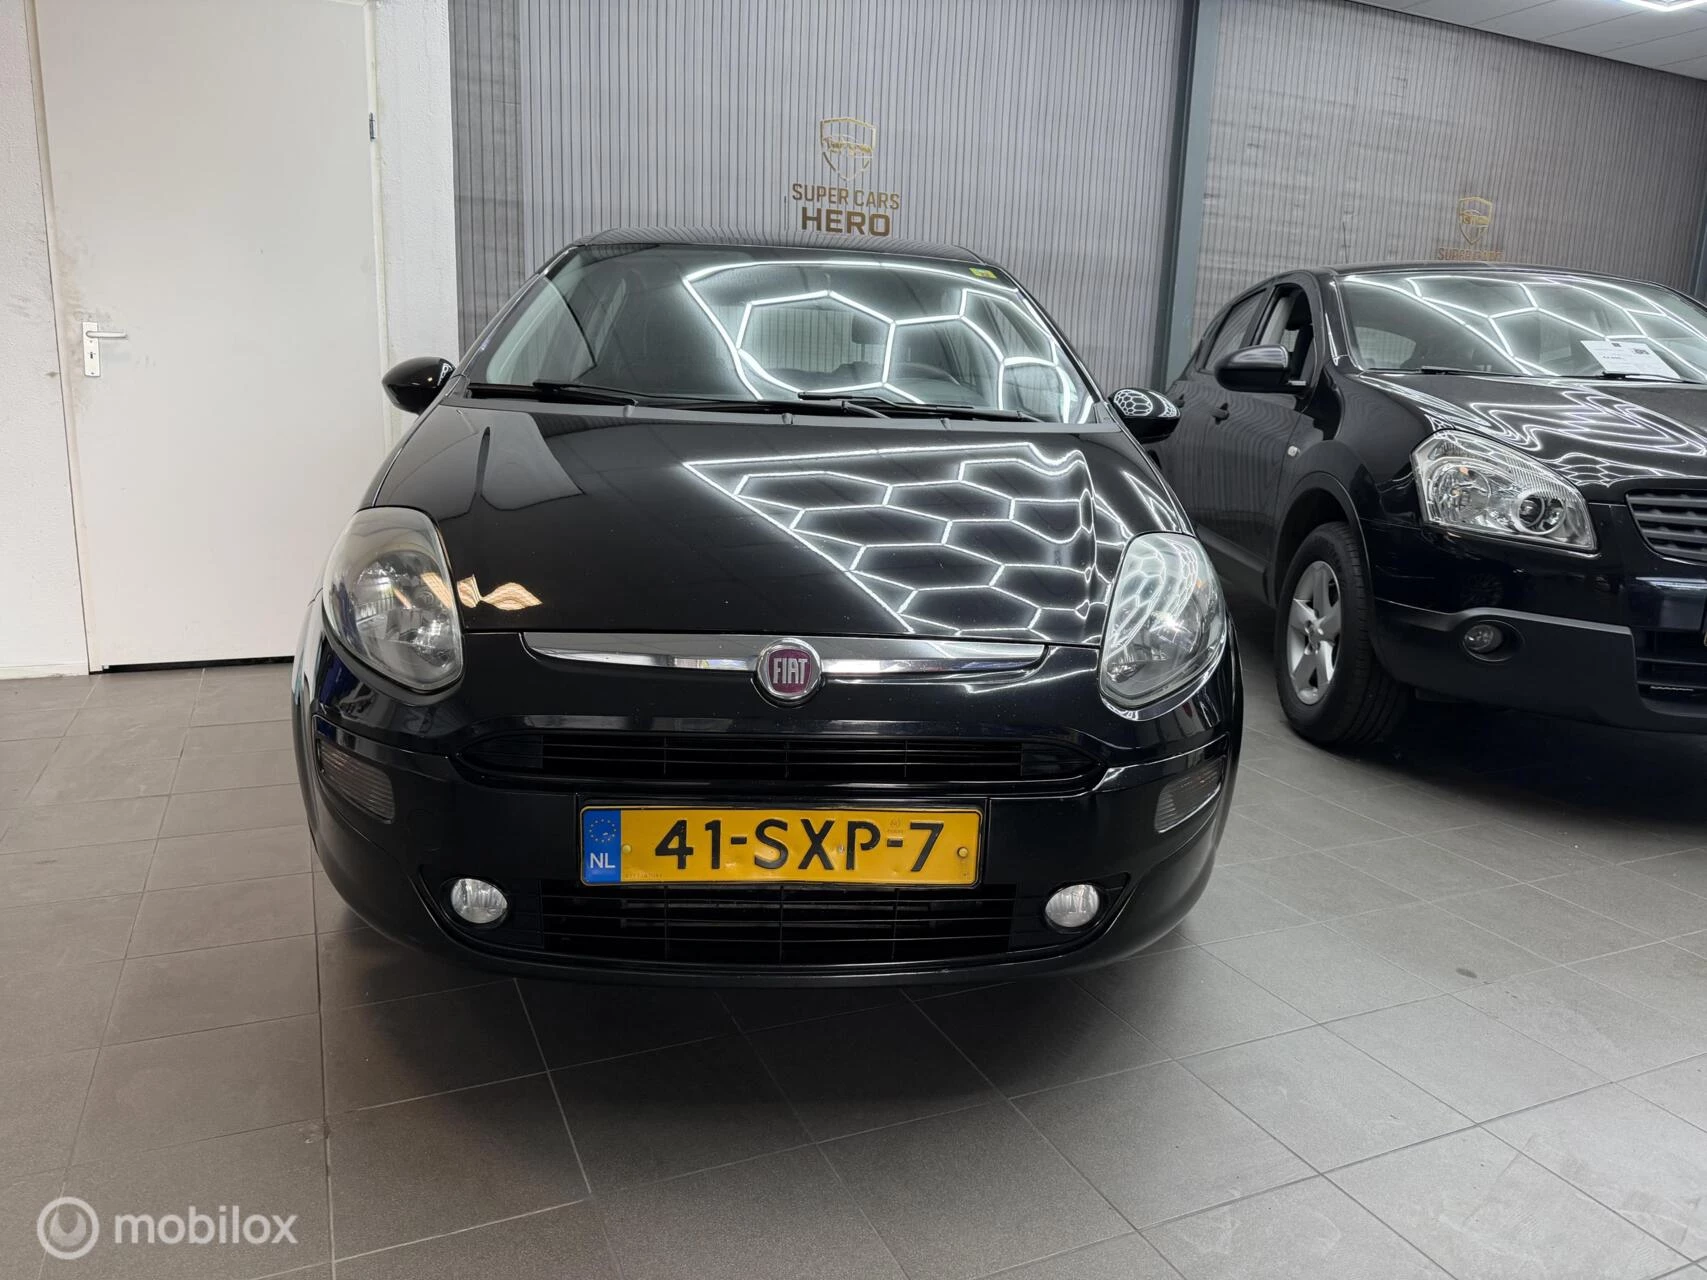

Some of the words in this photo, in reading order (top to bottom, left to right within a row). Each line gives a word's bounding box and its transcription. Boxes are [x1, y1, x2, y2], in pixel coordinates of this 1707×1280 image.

[792, 183, 849, 205] SUPER
[854, 190, 900, 210] CARS
[801, 206, 891, 237] HERO
[773, 657, 808, 684] FIAT
[654, 818, 944, 872] 41-SXP-7
[590, 852, 615, 869] NL
